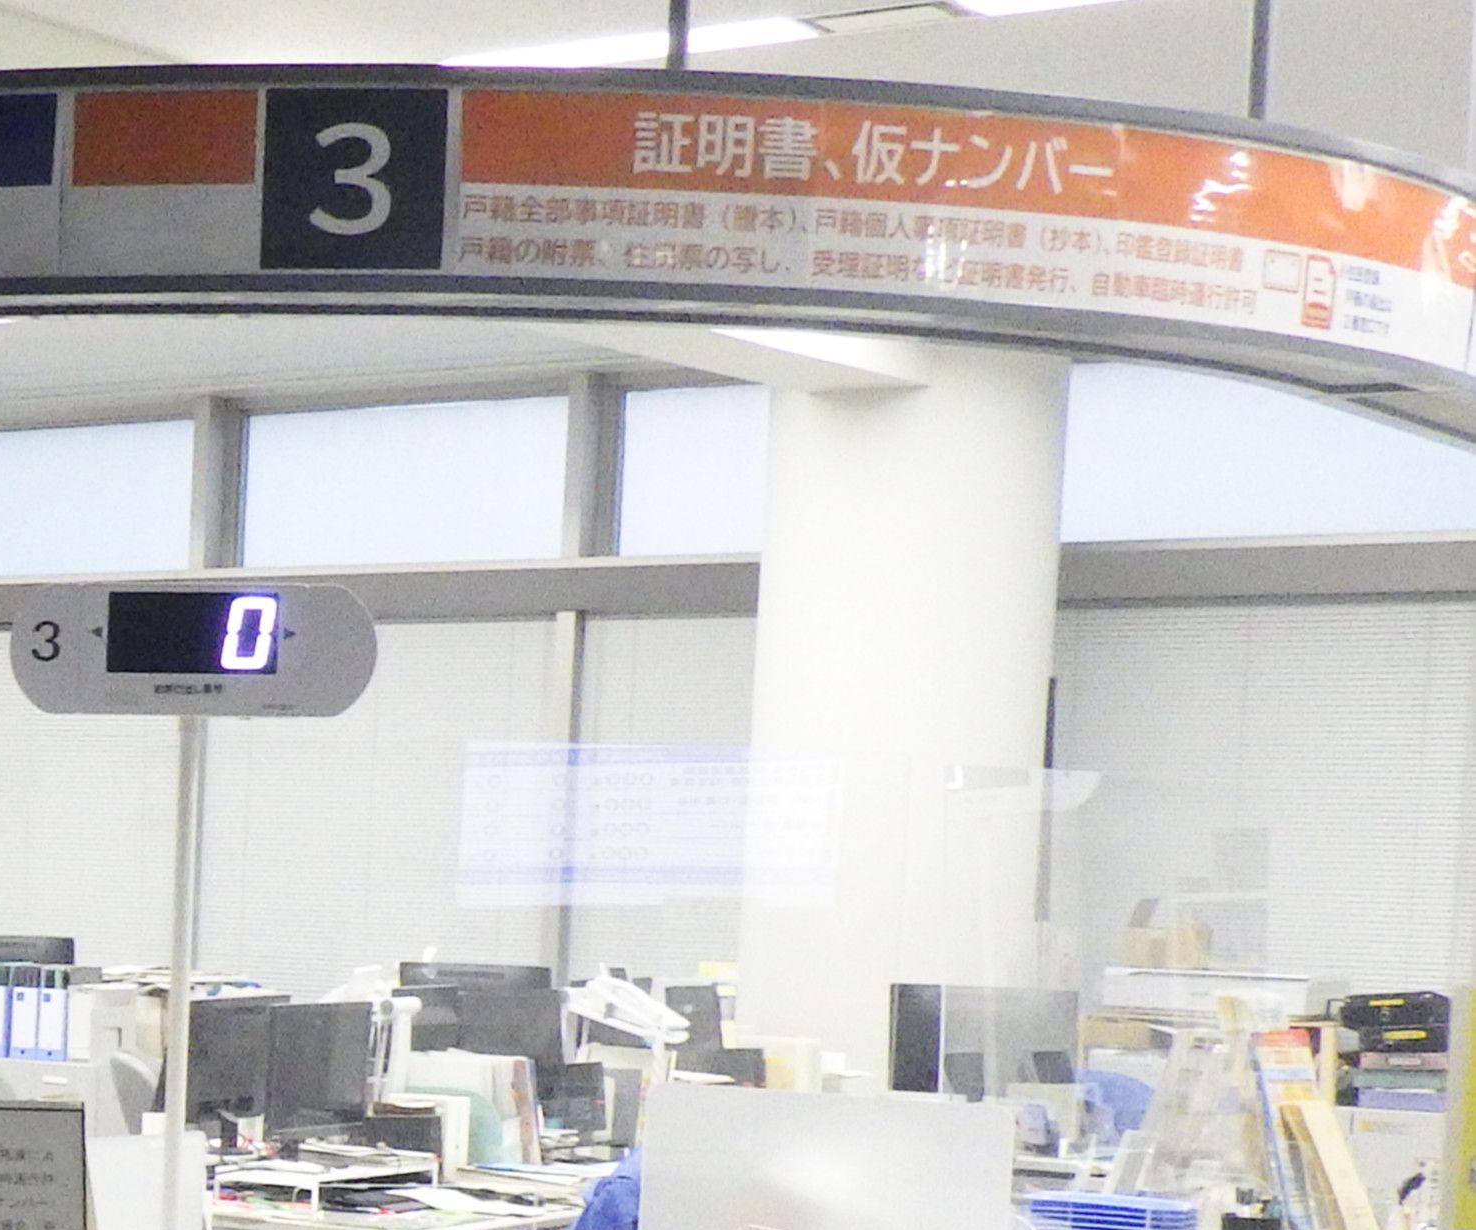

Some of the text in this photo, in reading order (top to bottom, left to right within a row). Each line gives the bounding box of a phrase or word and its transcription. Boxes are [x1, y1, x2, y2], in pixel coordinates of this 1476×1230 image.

[308, 122, 392, 236] 3
[633, 111, 1113, 194] 証明書、仮ナンバー
[32, 621, 61, 661] 3
[220, 596, 277, 671] 0
